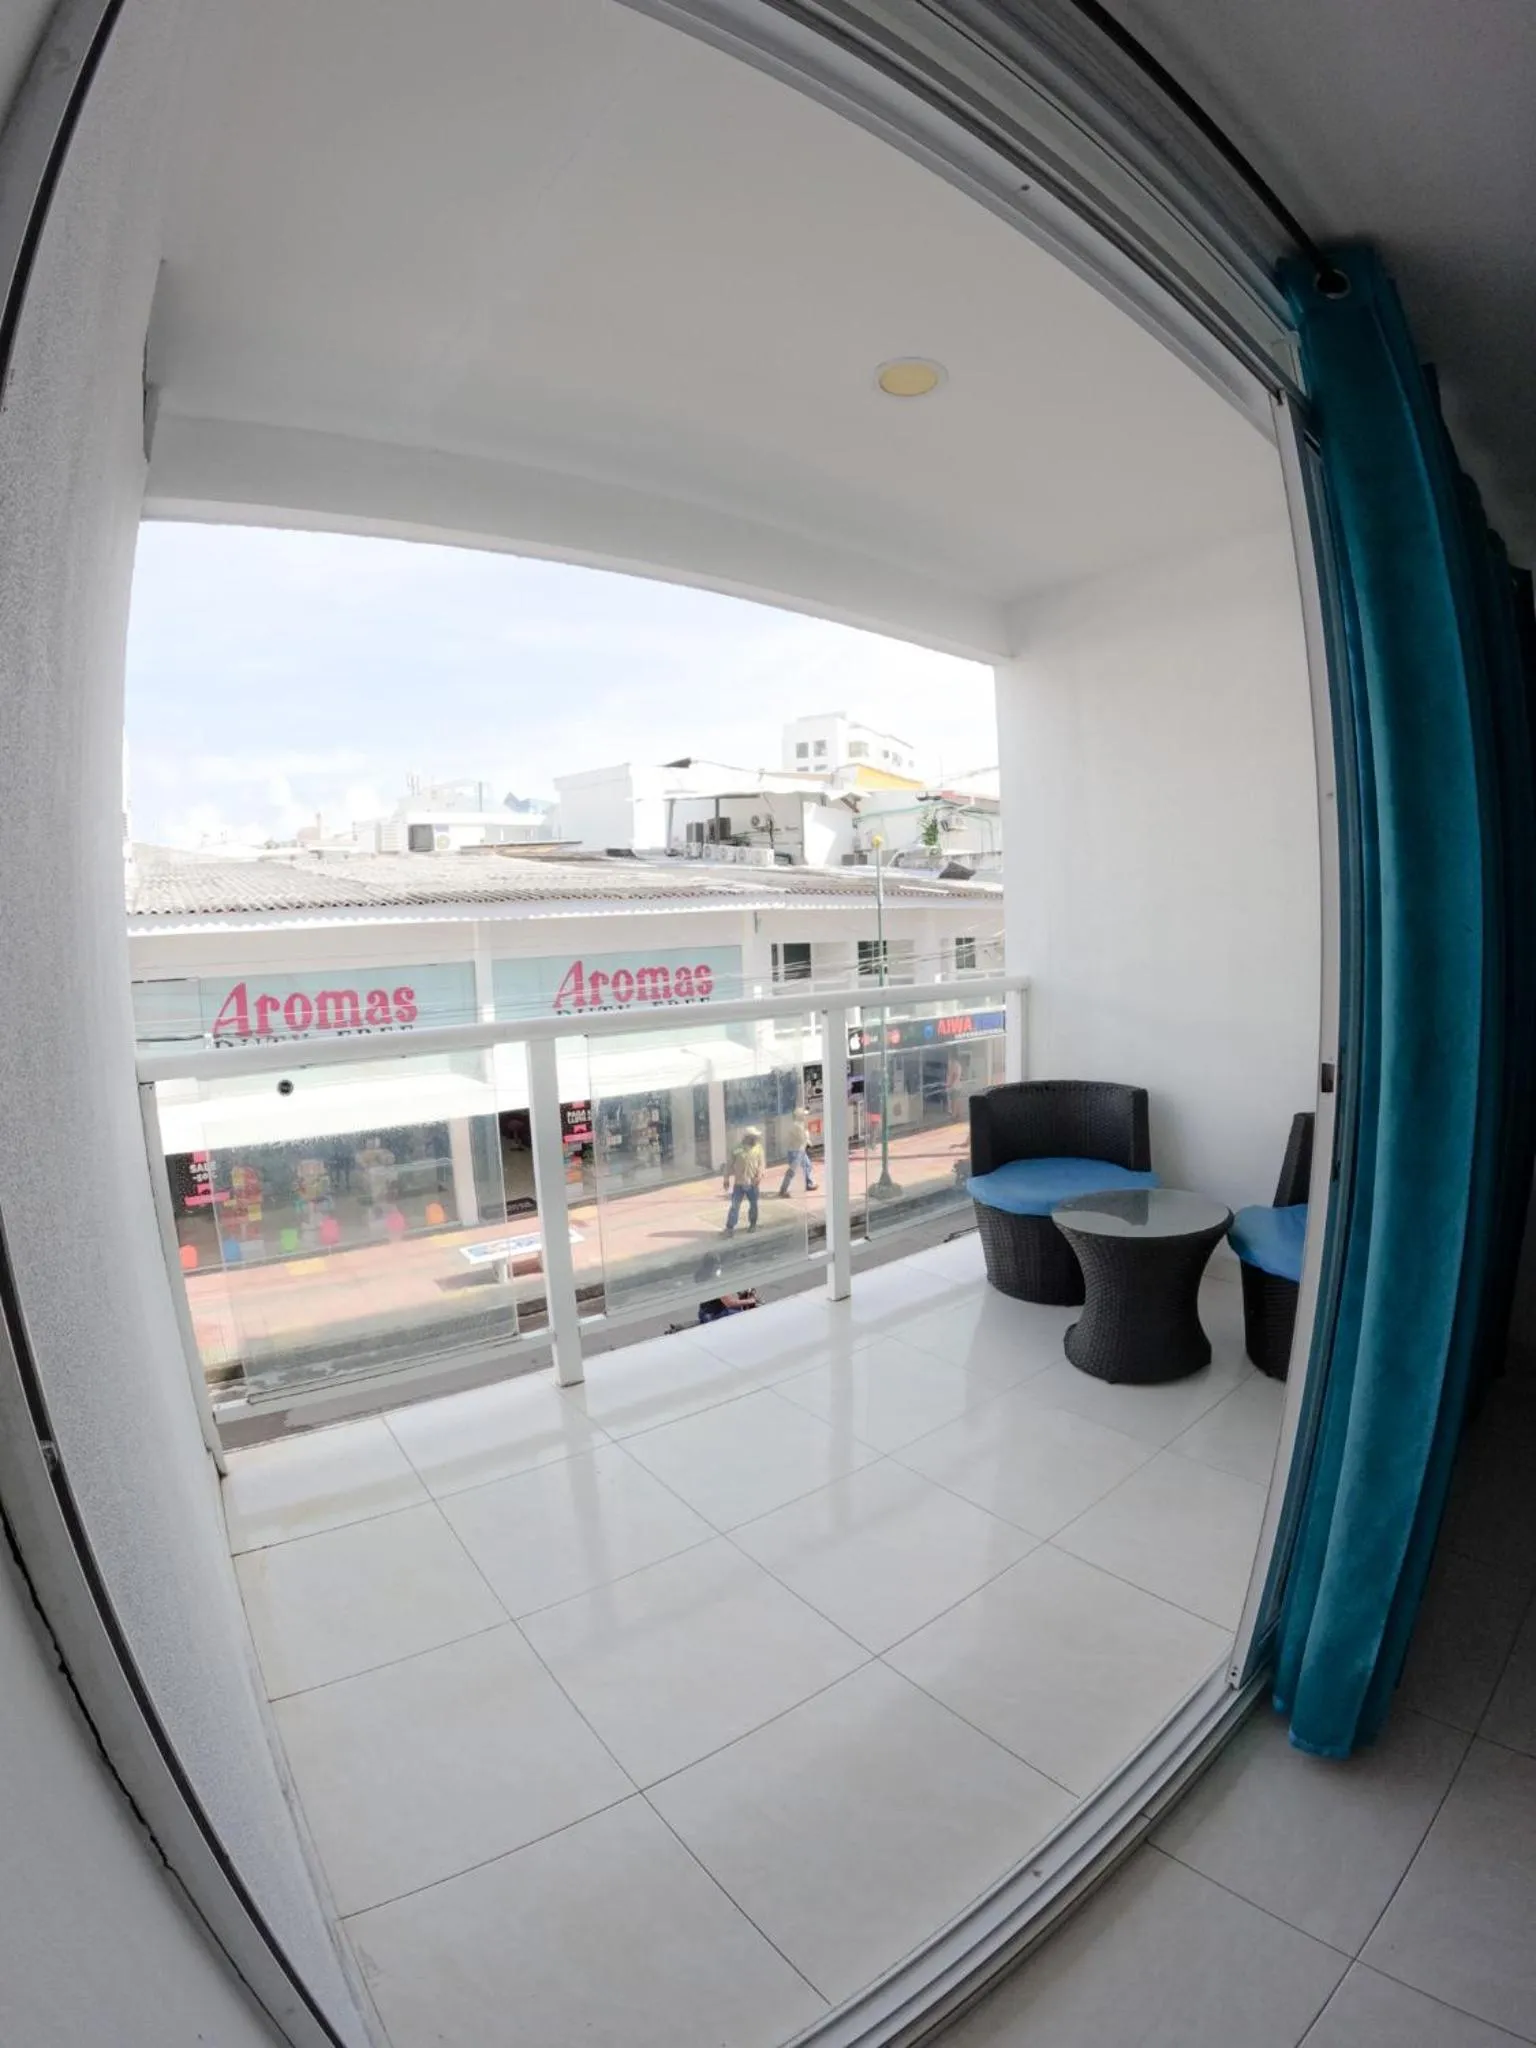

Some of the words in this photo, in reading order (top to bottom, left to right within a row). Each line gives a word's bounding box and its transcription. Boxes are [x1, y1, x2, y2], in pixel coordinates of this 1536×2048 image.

[552, 960, 713, 1008] Aromas
[212, 982, 418, 1038] Aromas
[937, 1015, 972, 1035] AIWA
[189, 1161, 217, 1174] SALE
